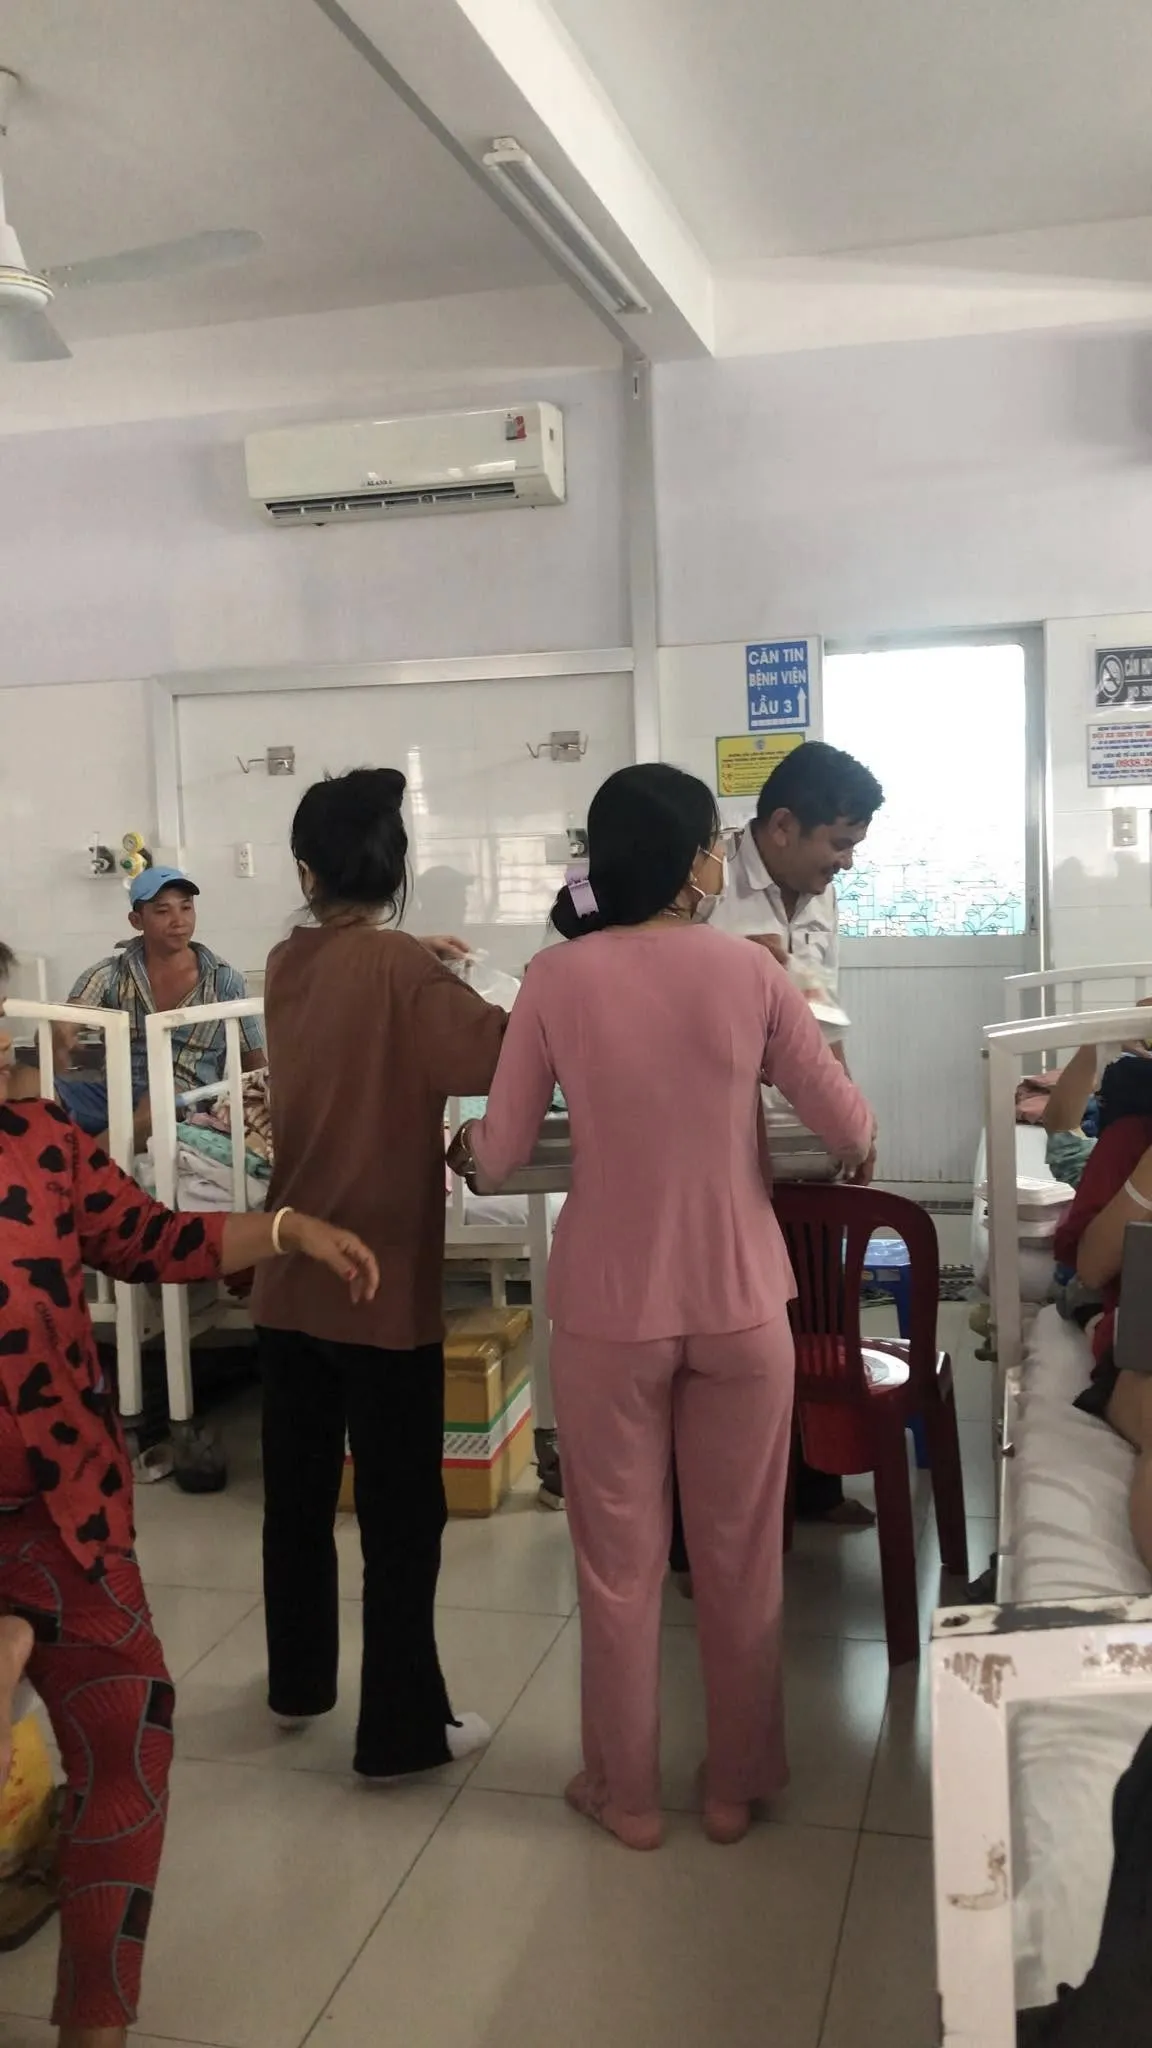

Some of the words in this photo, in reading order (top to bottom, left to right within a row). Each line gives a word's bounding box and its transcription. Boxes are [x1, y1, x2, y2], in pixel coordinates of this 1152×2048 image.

[748, 647, 780, 665] CĂN
[782, 647, 804, 662] TIN
[749, 669, 778, 691] BỆNH
[781, 666, 806, 688] VIỆN
[751, 694, 778, 715] LẦU
[783, 699, 793, 714] 3
